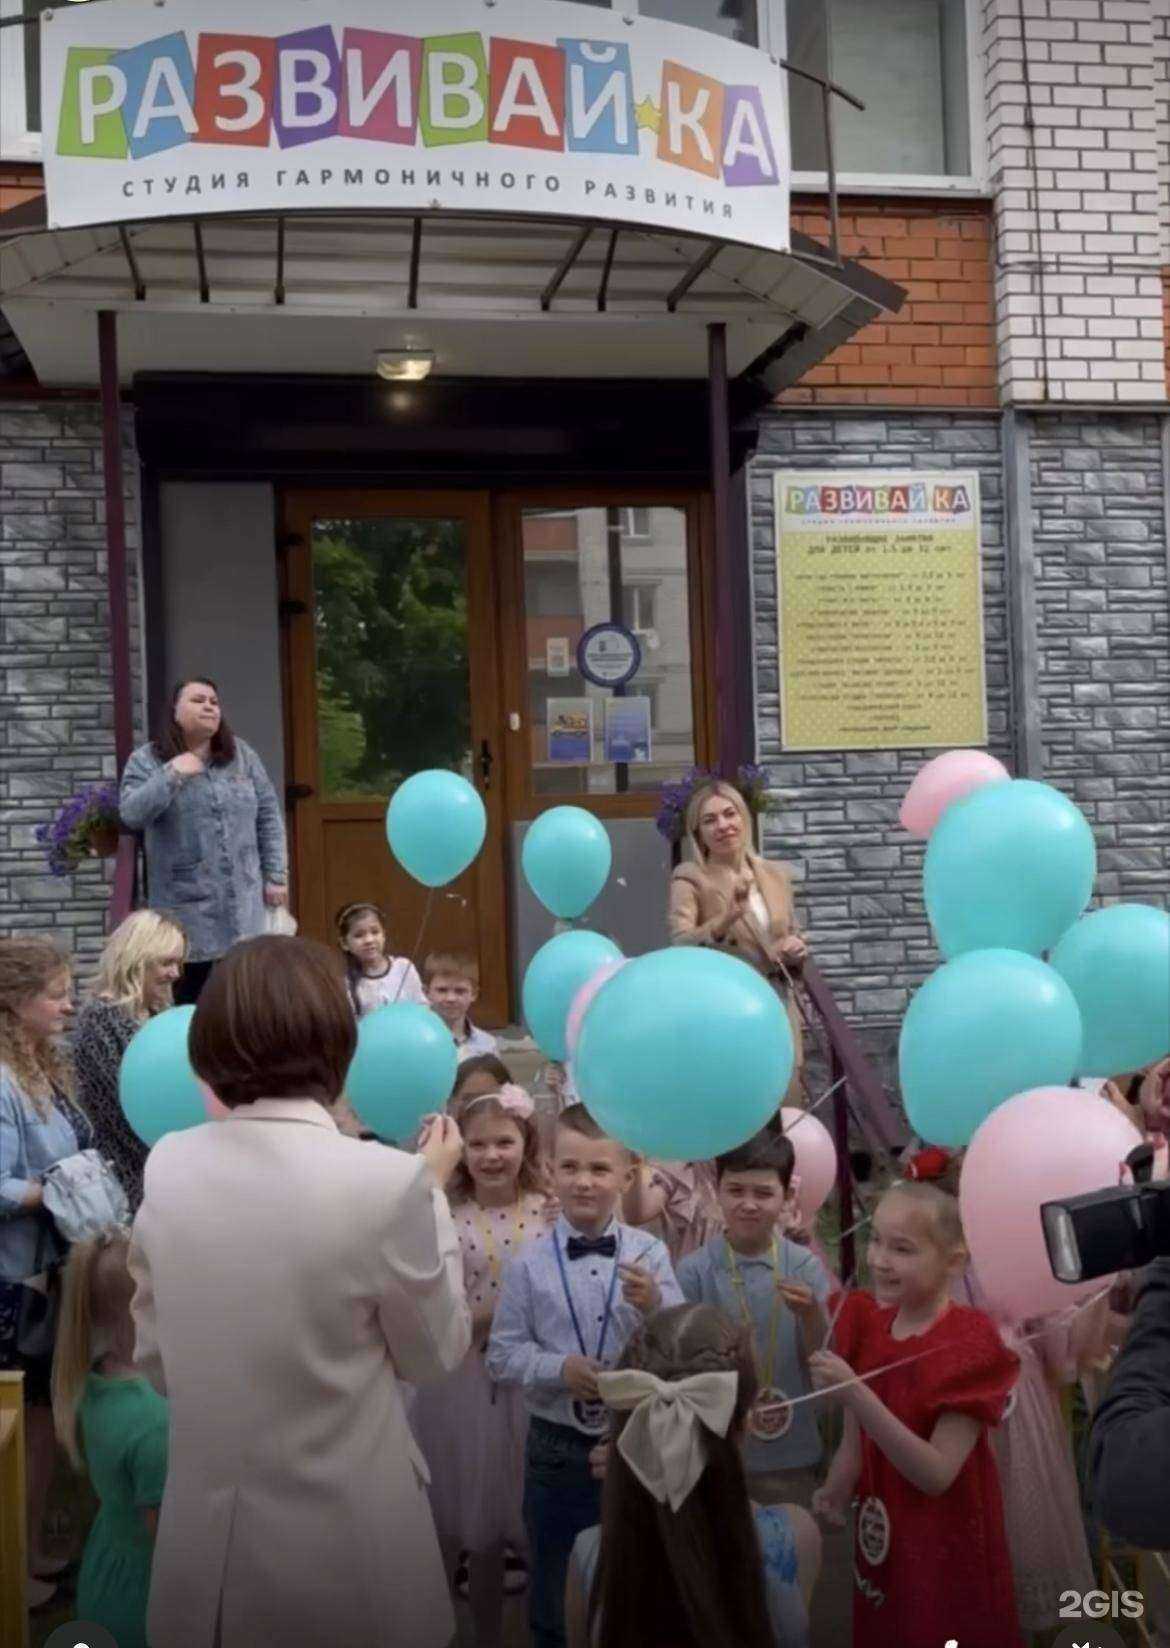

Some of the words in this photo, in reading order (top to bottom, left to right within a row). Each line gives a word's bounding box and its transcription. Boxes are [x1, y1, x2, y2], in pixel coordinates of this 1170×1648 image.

[122, 171, 250, 198] СТУДИЯ
[276, 168, 561, 193] ГАРМОНИЧНОГО
[584, 180, 734, 219] РАЗВИТИЯ
